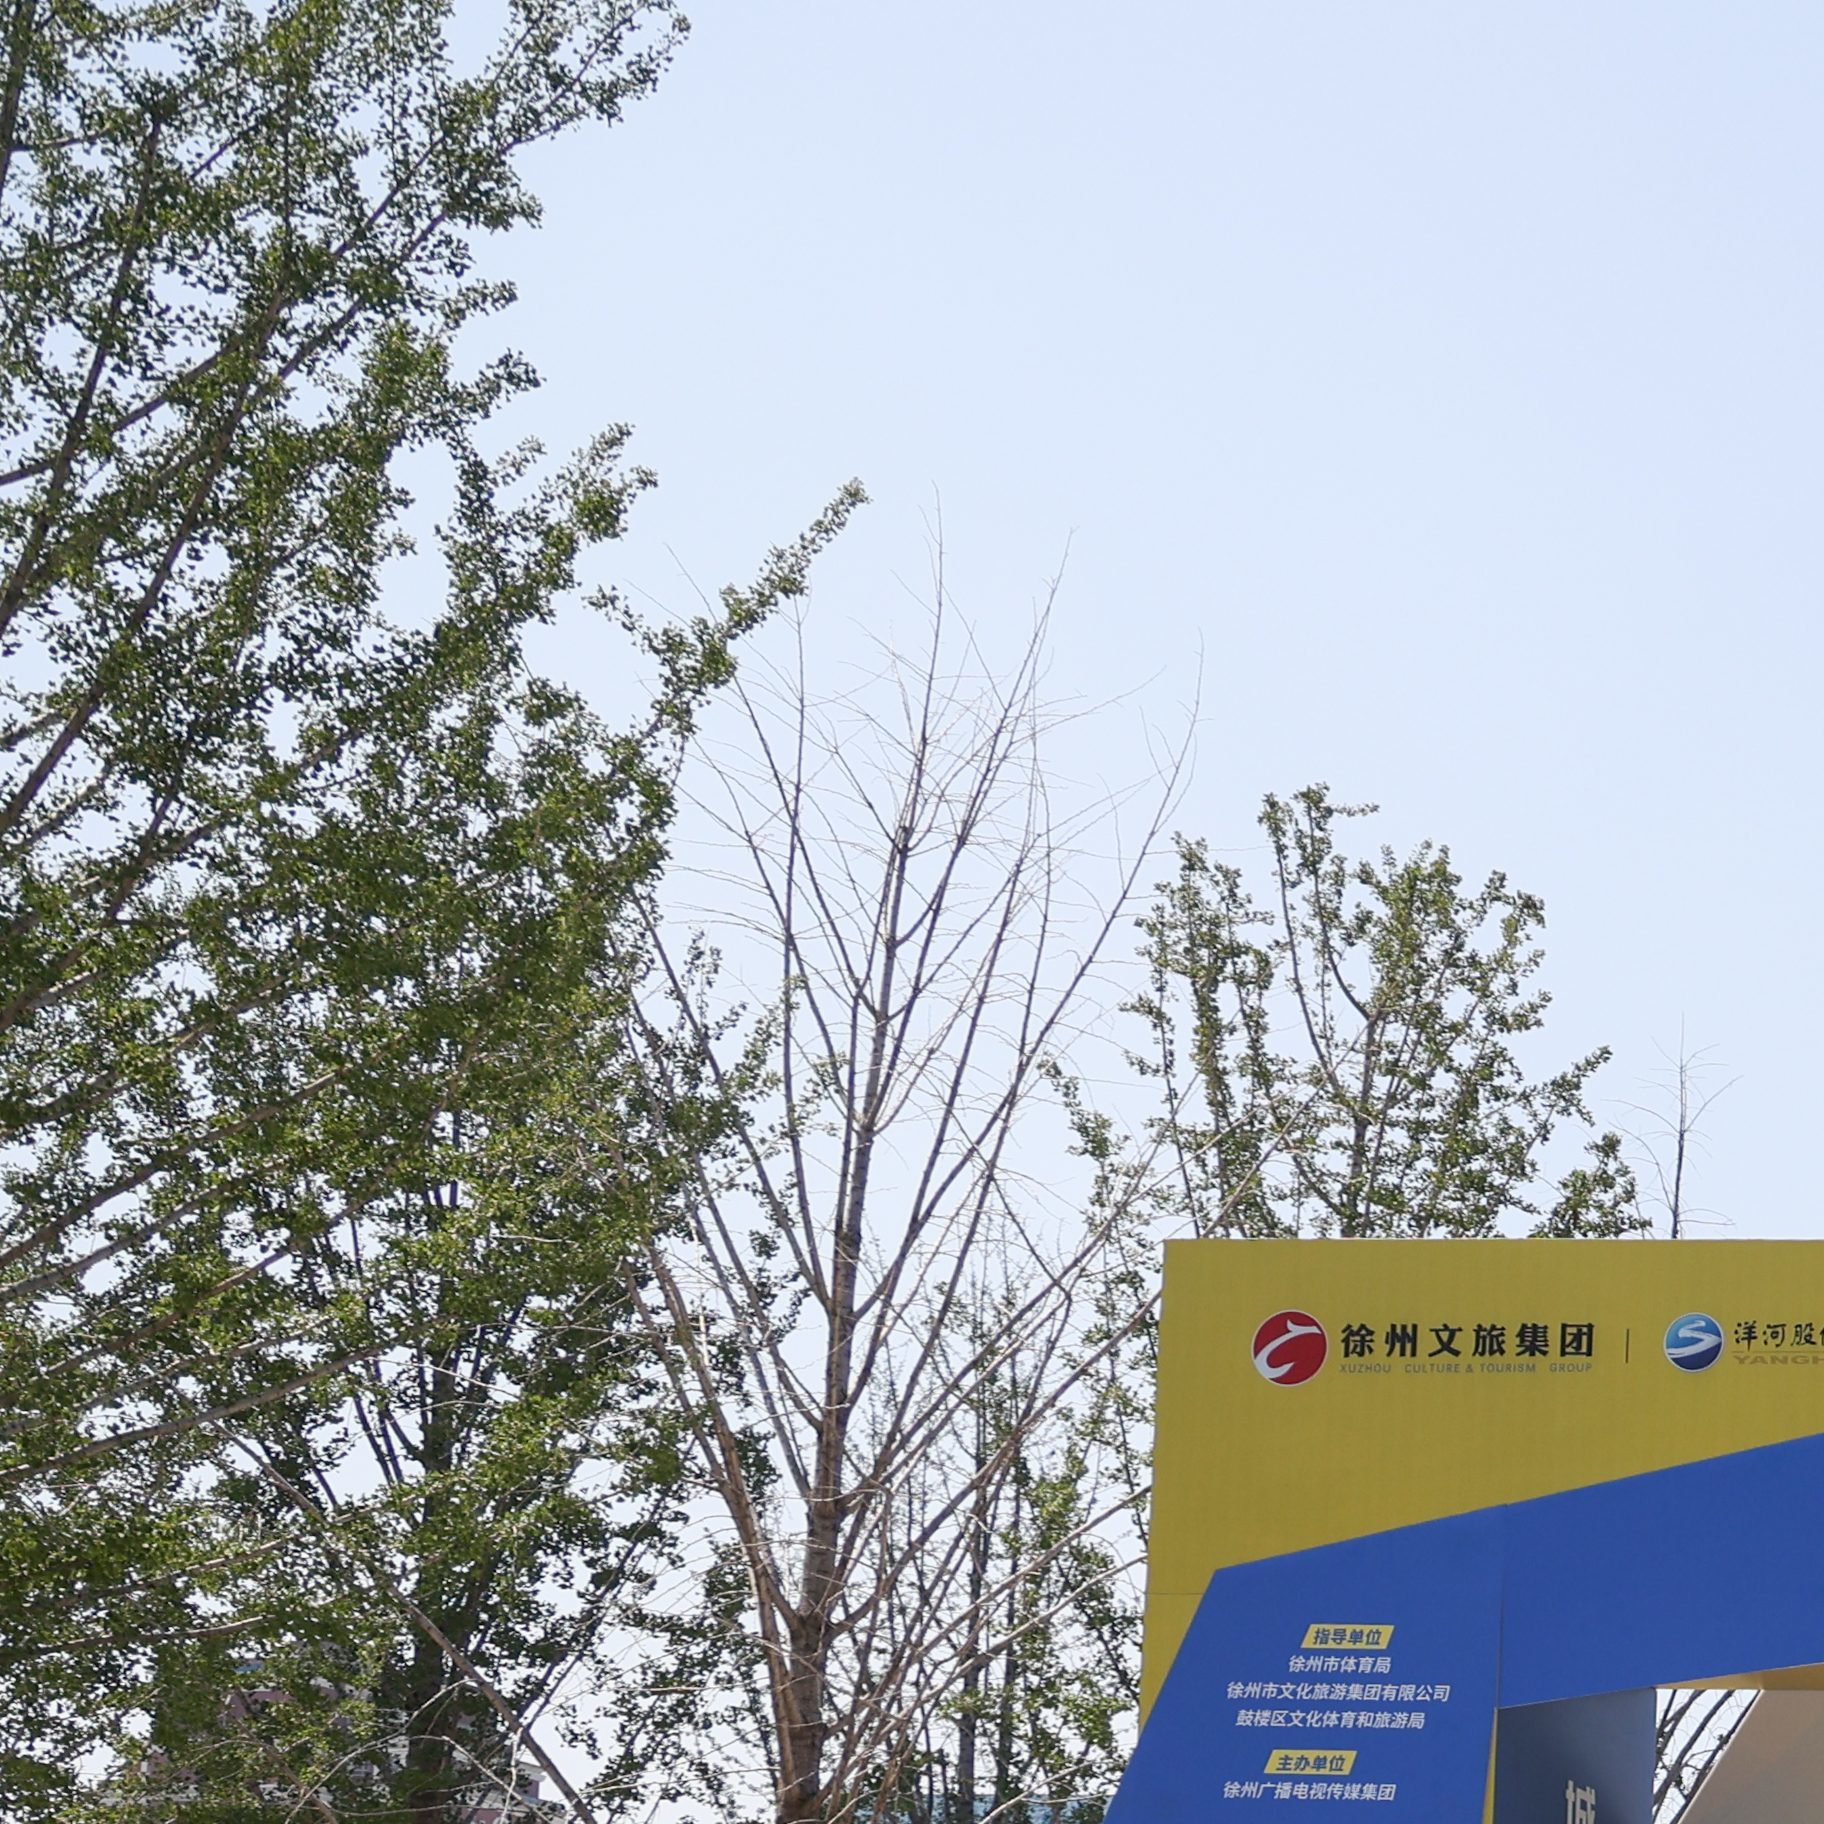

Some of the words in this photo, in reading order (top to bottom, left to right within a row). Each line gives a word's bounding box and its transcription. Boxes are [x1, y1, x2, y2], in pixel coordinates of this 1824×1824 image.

[1339, 1322, 1596, 1358] 徐州文旅集团
[1339, 1363, 1391, 1375] XUZHOU
[1404, 1363, 1462, 1375] CULTURE
[1465, 1363, 1475, 1375] &
[1479, 1363, 1537, 1375] TOURISM
[1549, 1362, 1593, 1374] GROUP
[1313, 1628, 1382, 1646] 指导单位
[1288, 1655, 1392, 1674] 徐州市体育局
[1226, 1681, 1451, 1703] 徐州市文化旅游集团有限公司
[1235, 1709, 1425, 1730] 鼓楼区文化体育和旅游局
[1276, 1755, 1346, 1773] 主办单位
[1223, 1780, 1396, 1802] 徐州广播电视传媒集团
